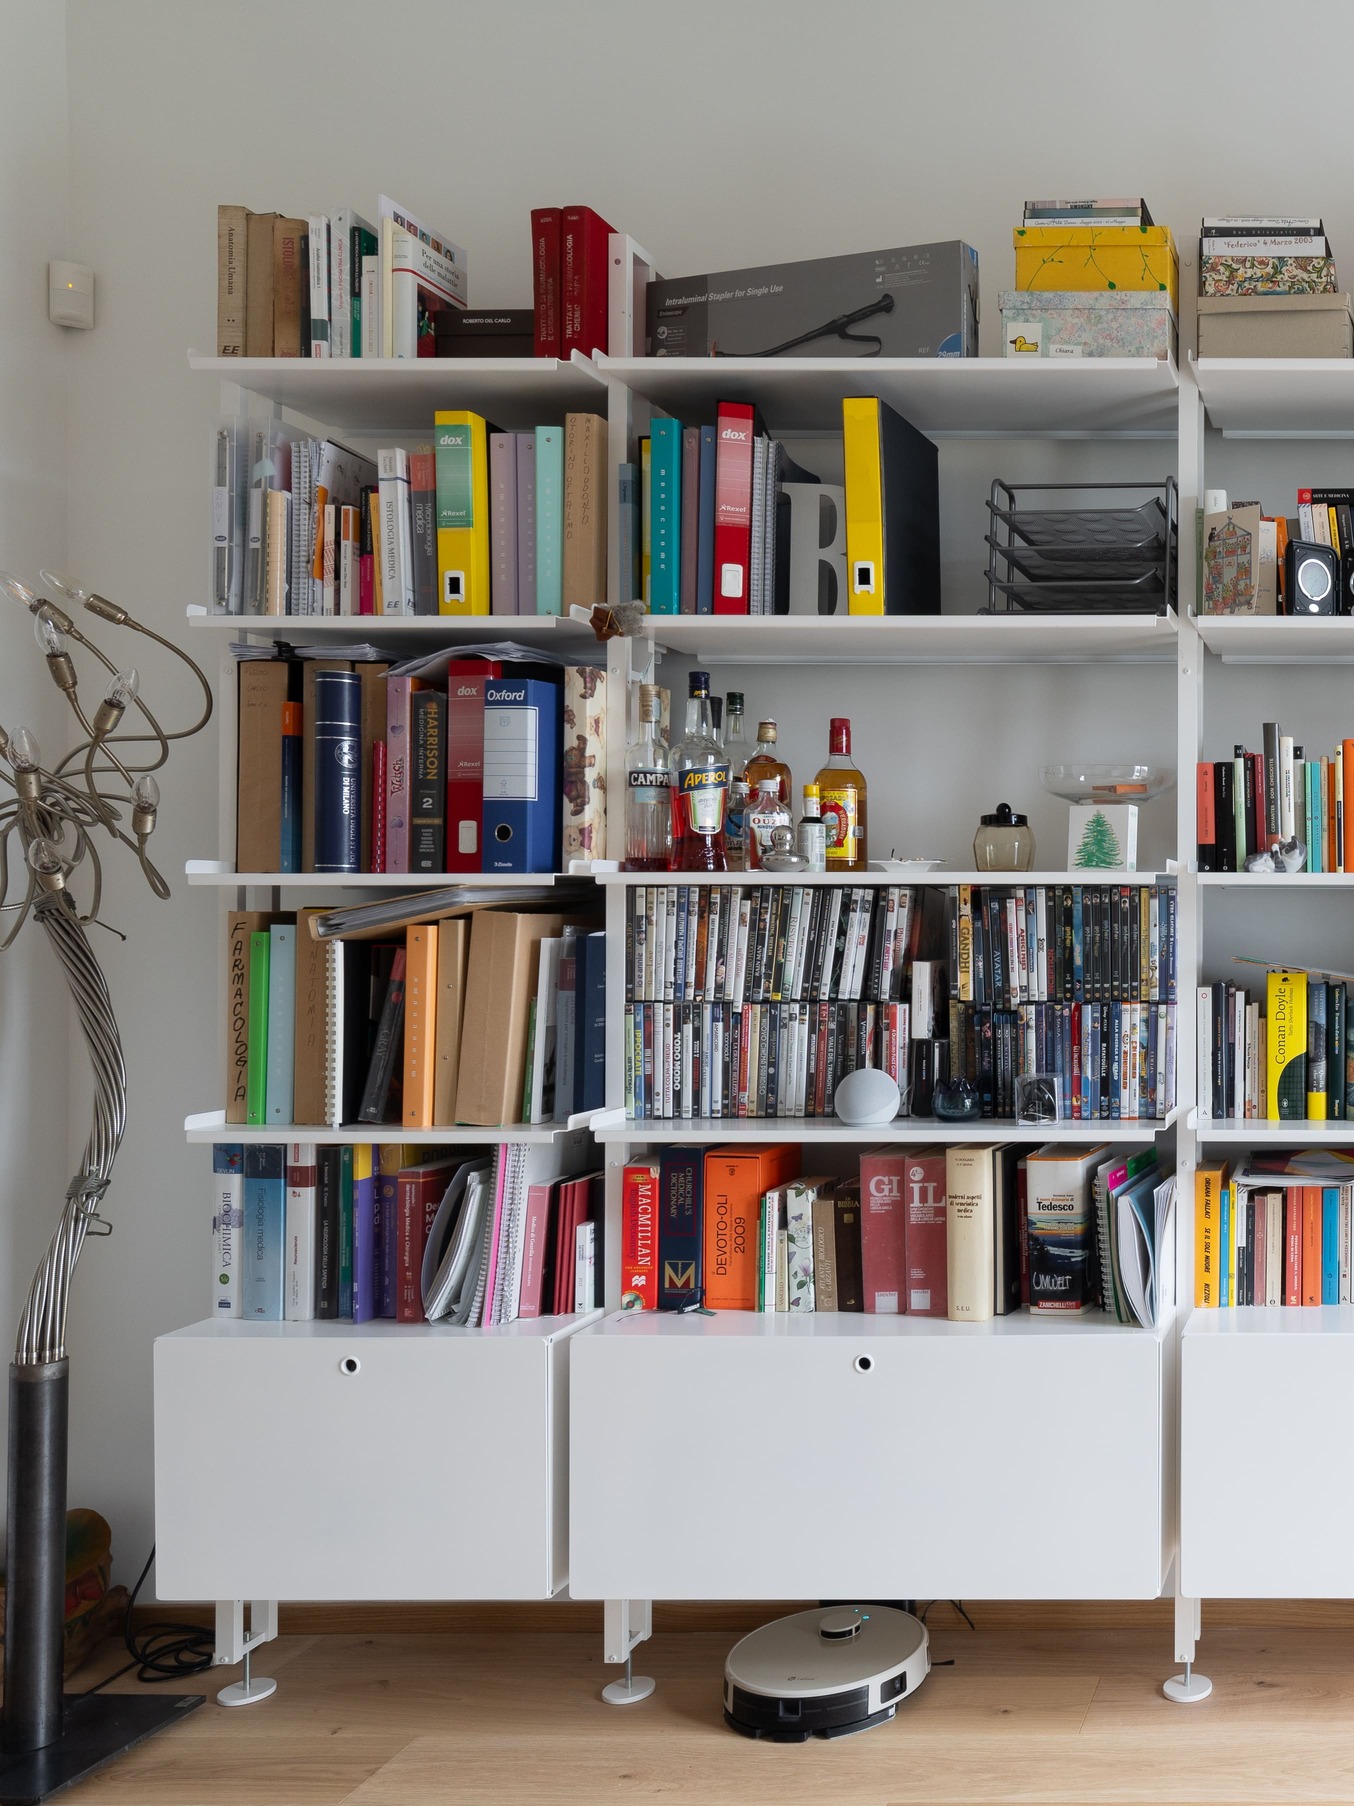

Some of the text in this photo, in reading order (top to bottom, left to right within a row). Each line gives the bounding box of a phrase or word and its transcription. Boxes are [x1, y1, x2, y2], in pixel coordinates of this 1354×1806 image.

[227, 225, 235, 268] Anatomia
[1269, 238, 1292, 247] Marzo
[1293, 236, 1314, 245] 2003
[665, 284, 784, 306] Intraluminal Stapler for Single Use
[1055, 346, 1074, 355] Chiara
[439, 435, 463, 446] dox
[722, 429, 747, 441] dox
[726, 505, 746, 513] Rexel
[386, 500, 396, 581] ISTOLOGIA MEDICA
[457, 686, 478, 696] dox
[487, 690, 525, 701] Oxford
[427, 707, 438, 780] HARRISON
[685, 771, 727, 788] APEROL
[342, 787, 350, 815] MILANO
[422, 797, 433, 808] 2
[786, 916, 797, 963] RISVEGLI
[960, 926, 970, 974] GANDHI
[993, 951, 1001, 987] AVATAR
[1274, 986, 1288, 1065] Conan Doyle
[634, 1029, 642, 1075] IPPOCRATE
[670, 1173, 678, 1219] DICTIONARY
[685, 1168, 693, 1216] CHURCHILL'S
[869, 1176, 901, 1196] GI
[909, 1183, 946, 1207] IL
[838, 1200, 859, 1208] BIBBIA
[1036, 1201, 1074, 1212] Tedesco
[222, 1192, 232, 1268] BIOCHIMICA
[256, 1187, 266, 1261] Fisiologia medica
[638, 1184, 652, 1266] MACMILLAN
[716, 1194, 728, 1276] DEVOTO-OLI
[733, 1217, 746, 1254] 2009
